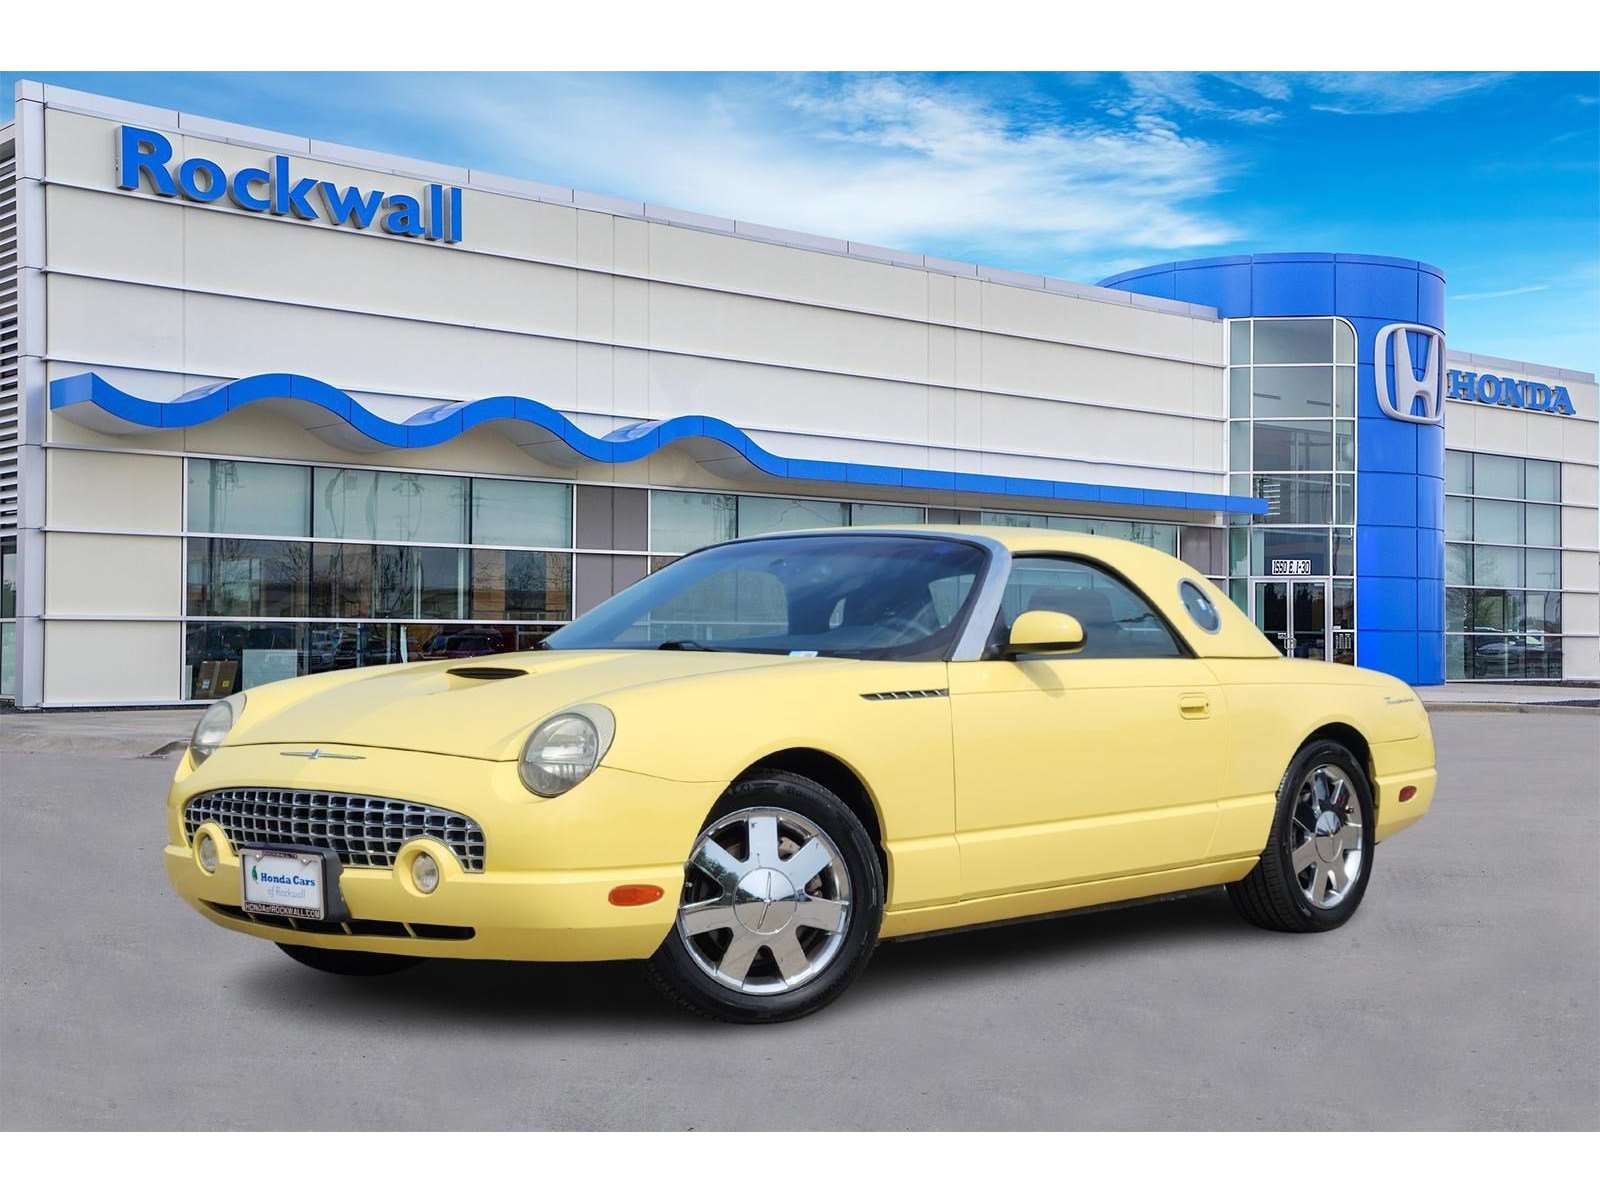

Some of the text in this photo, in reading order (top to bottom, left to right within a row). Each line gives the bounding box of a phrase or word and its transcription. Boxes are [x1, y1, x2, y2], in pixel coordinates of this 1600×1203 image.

[115, 125, 463, 244] Rockwall
[1446, 368, 1576, 416] HONDA
[1273, 560, 1288, 574] 1550
[260, 872, 316, 887] Honda Cars
